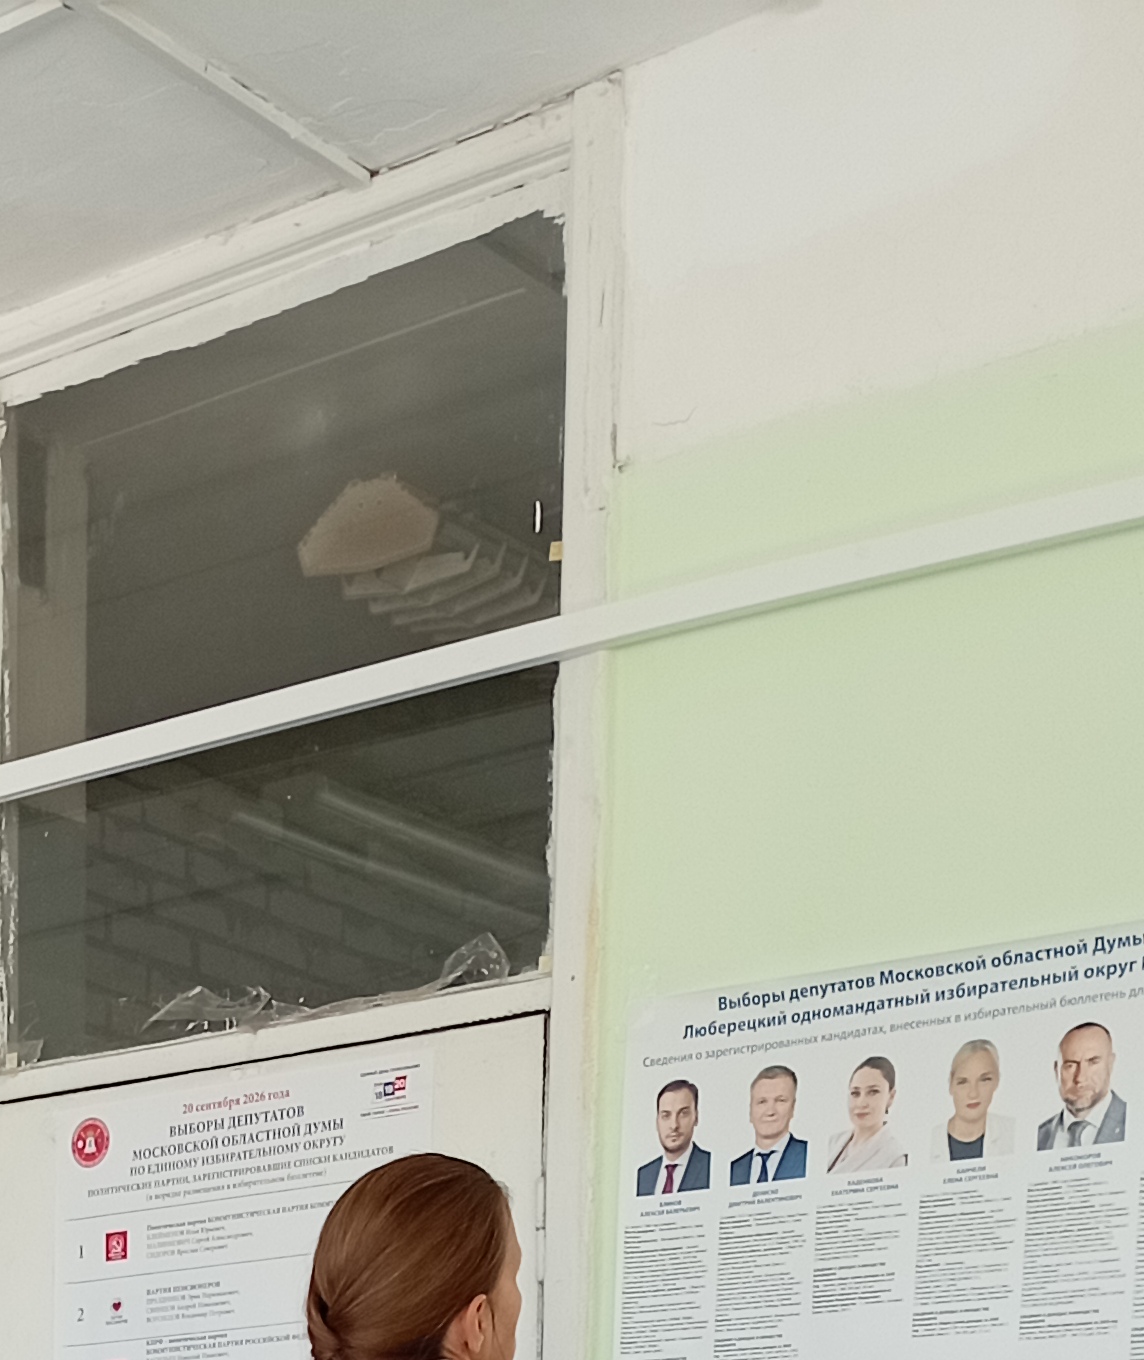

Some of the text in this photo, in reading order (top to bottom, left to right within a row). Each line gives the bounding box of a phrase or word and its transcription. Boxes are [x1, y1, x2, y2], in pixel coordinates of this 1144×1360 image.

[718, 991, 786, 1012] Выборы
[789, 974, 875, 1003] депутатов
[879, 954, 986, 986] Московской
[991, 939, 1088, 967] областной
[683, 1010, 787, 1040] Люберецкий
[791, 989, 931, 1025] одномандатный
[935, 965, 1079, 1002] избирательный
[1084, 959, 1137, 980] округ
[643, 1052, 693, 1068] Сведения
[695, 1051, 703, 1060] о
[705, 1034, 818, 1060] зарегистрированных
[821, 1025, 887, 1043] кандидатах,
[890, 1016, 952, 1033] внесенных
[954, 1014, 961, 1023] в
[964, 998, 1057, 1022] избирательный
[1059, 988, 1126, 1007] бюллетень
[169, 1105, 305, 1138] ВЫБОРЫ ДЕПУТАТОВ
[182, 1089, 290, 1115] 20 сентября 2026 года
[129, 1135, 346, 1177] ПО ЕДИНОМУ ИЗБИРАТЕЛЬНОМУ ОКРУГУ
[132, 1118, 344, 1161] МОСКОВСКОЙ ОБЛАСТНОЙ ДУМЫ
[87, 1180, 152, 1198] ПОЛИТИЧЕСКИЕ
[193, 1160, 292, 1184] ЗАРЕГИСТРИРОВАВШИЕ
[293, 1154, 331, 1168] СПИСКИ
[332, 1145, 394, 1163] КАНДИДАТОВ
[79, 1245, 84, 1259] 1
[77, 1308, 84, 1322] 2
